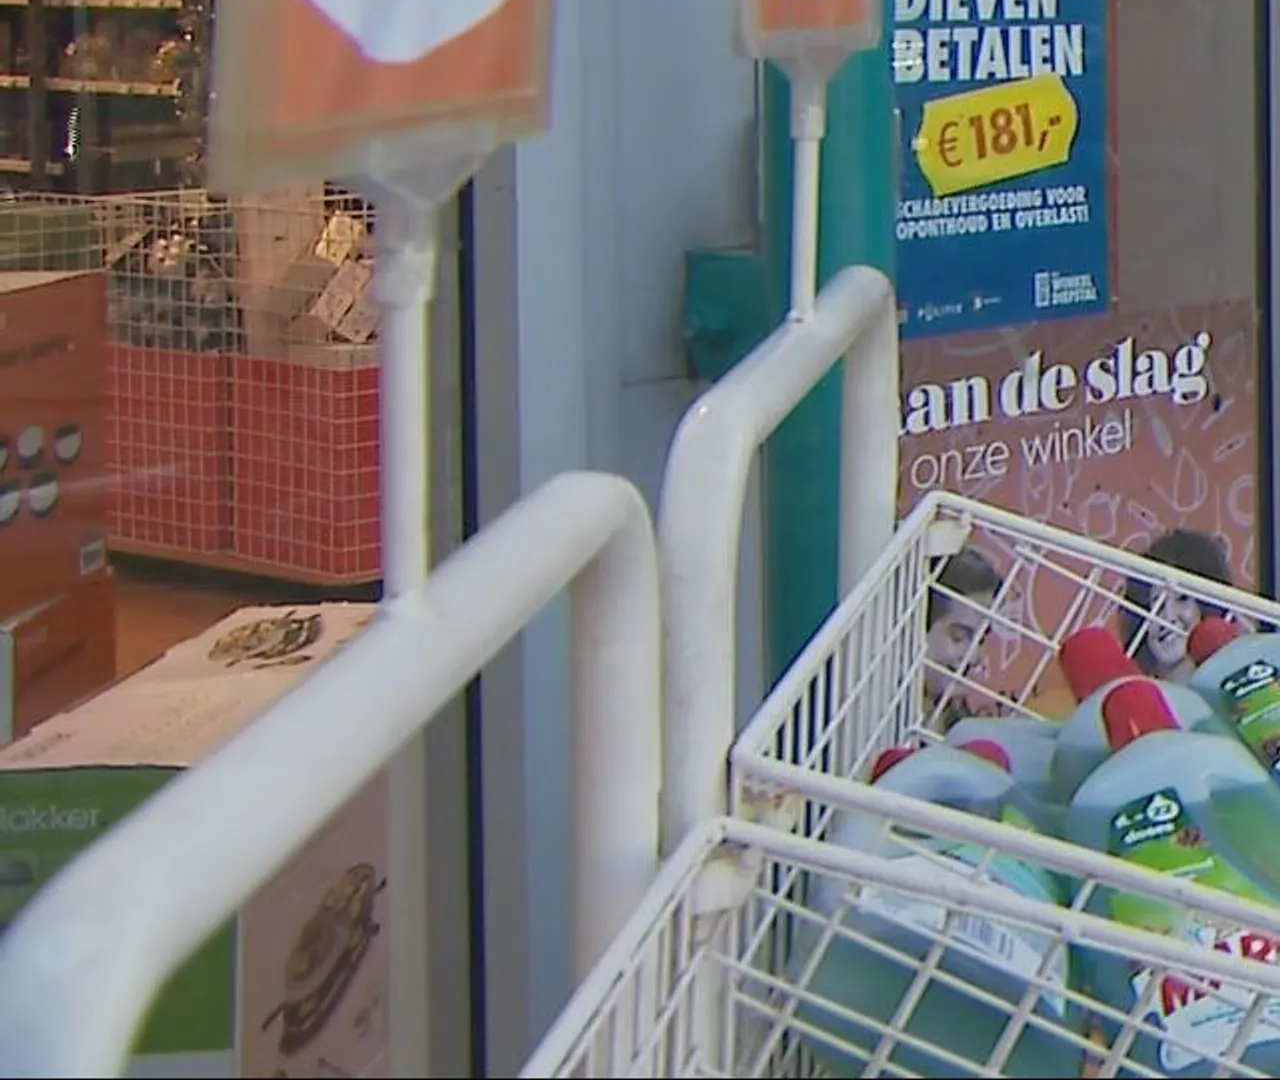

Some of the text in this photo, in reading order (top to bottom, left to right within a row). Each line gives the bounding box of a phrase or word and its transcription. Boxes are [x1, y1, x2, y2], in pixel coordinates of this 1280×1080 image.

[895, 24, 1086, 85] BETALEN
[896, 213, 988, 241] OPONTHOUD
[992, 210, 1011, 232] EN
[1047, 186, 1087, 206] VOOR
[899, 373, 993, 437] an
[999, 349, 1078, 418] de
[910, 407, 1133, 490] onze winkel
